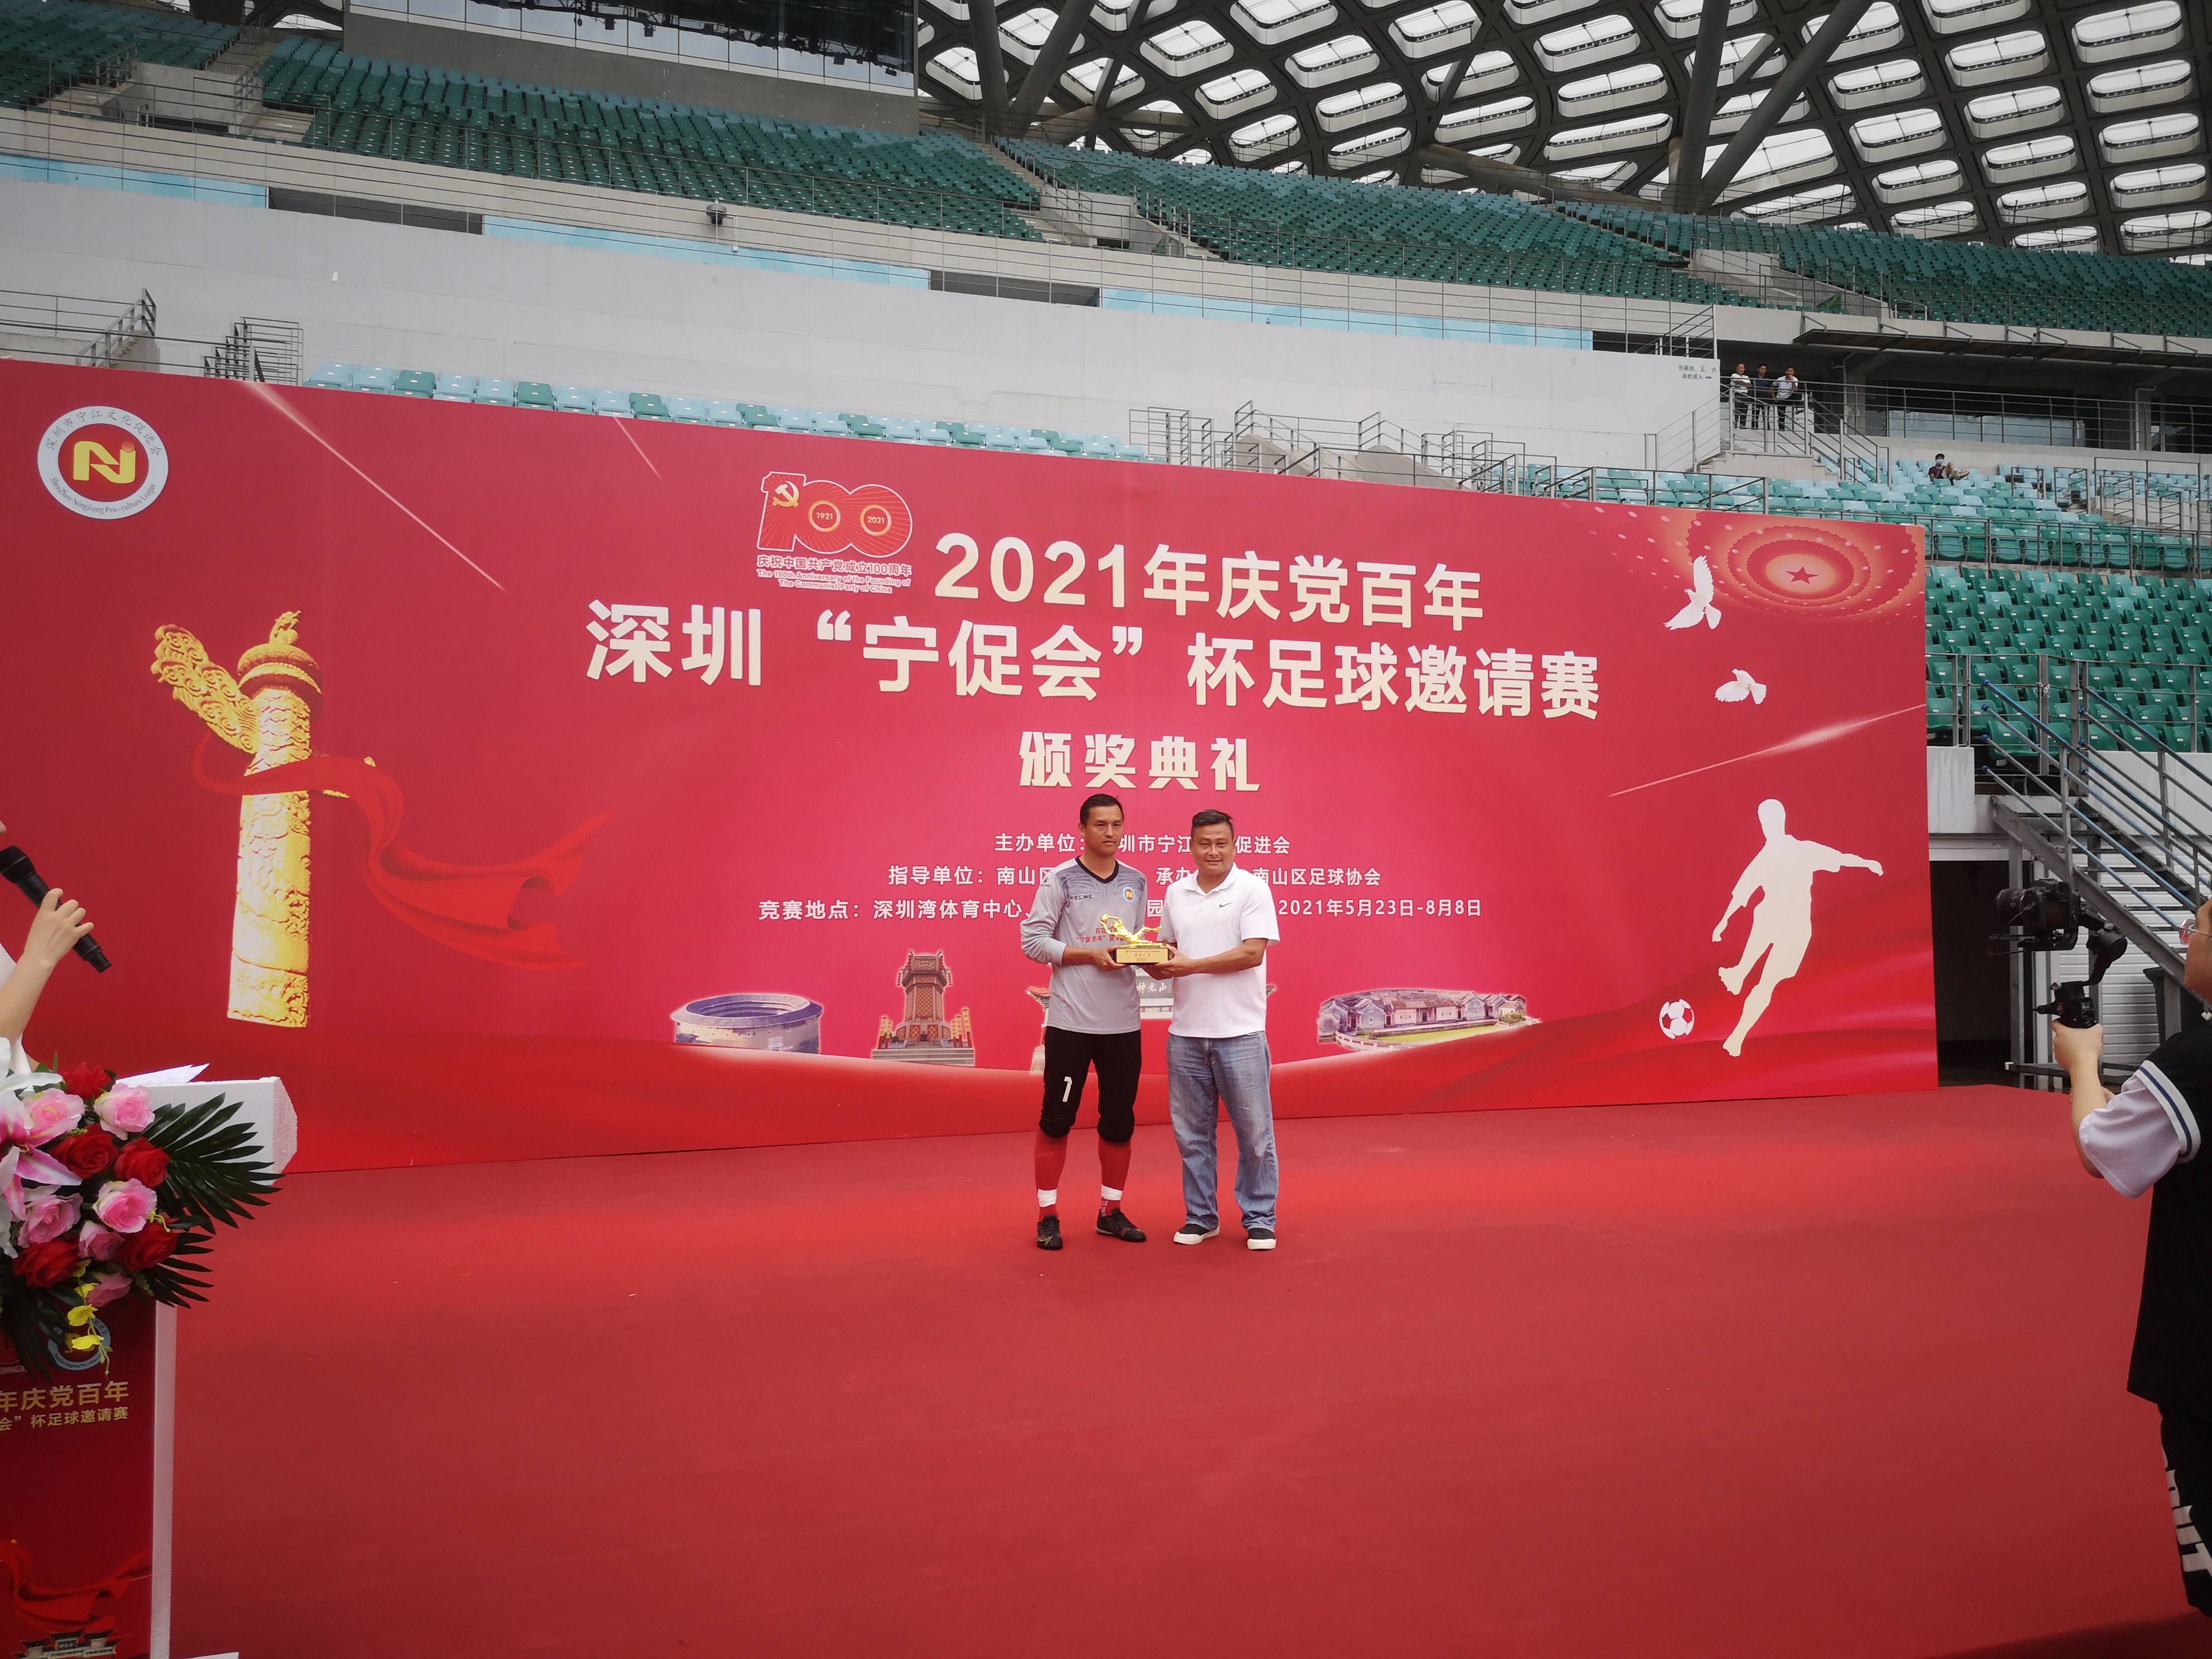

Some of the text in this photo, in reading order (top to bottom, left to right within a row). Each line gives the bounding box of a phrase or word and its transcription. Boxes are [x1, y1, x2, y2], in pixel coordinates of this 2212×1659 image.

[46, 410, 162, 455] 深圳市宁江文化促进会
[73, 498, 104, 514] Ningjiang
[105, 499, 143, 513] Pro-culture
[140, 483, 157, 501] League
[816, 512, 833, 521] 1921
[867, 515, 885, 525] 2021
[756, 555, 913, 576] 庆祝中国共产党成立100周年
[795, 581, 838, 590] Communist
[840, 584, 860, 593] Party
[797, 573, 841, 583] Anniversary
[866, 577, 900, 586] Founding
[933, 533, 1484, 631] 2021年庆党百年
[1018, 731, 1260, 792] 颁奖典礼
[1278, 898, 1481, 917] 2021年5月23日-8月8日
[1136, 982, 1167, 994] 神光山
[0, 1381, 129, 1413] 年庆党百年
